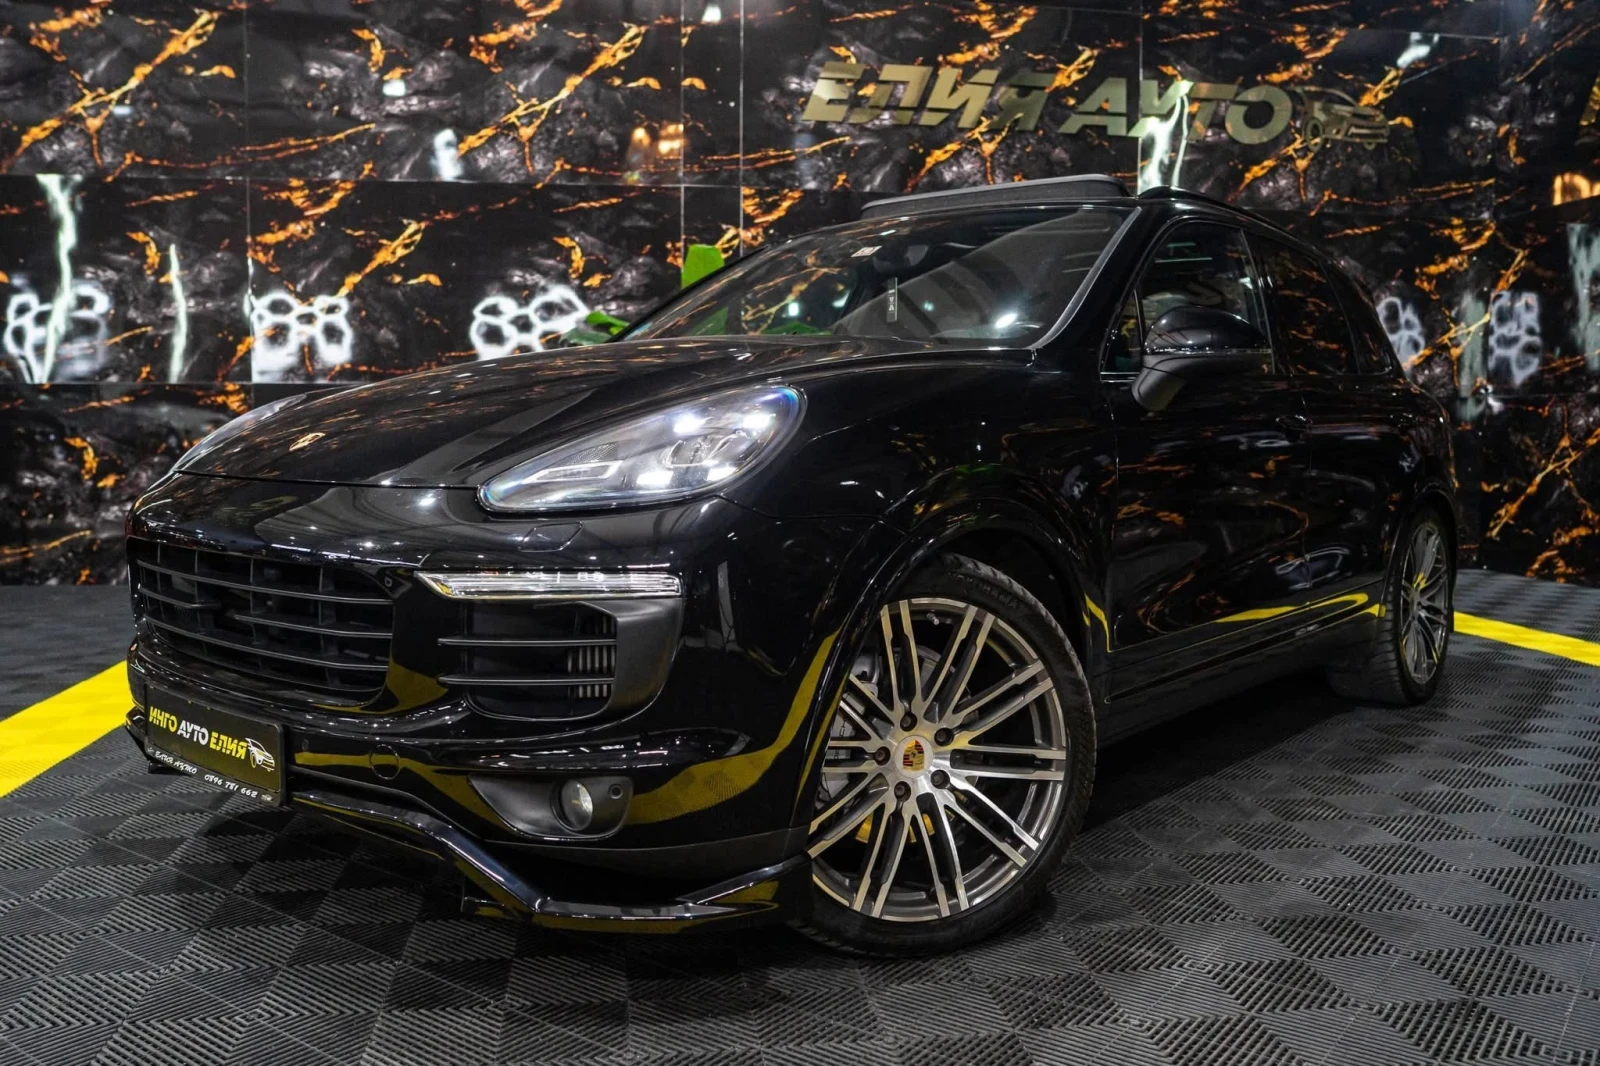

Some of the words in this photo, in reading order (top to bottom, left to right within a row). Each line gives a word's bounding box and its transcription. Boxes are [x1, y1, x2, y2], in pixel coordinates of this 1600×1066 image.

[801, 61, 1058, 132] ЕЛИЯ
[148, 706, 178, 732] ИНГО
[177, 720, 209, 745] АУТО
[209, 731, 248, 760] ЕЛИЯ
[204, 774, 223, 786] 0896
[224, 781, 239, 791] 781
[240, 787, 258, 798] 662
